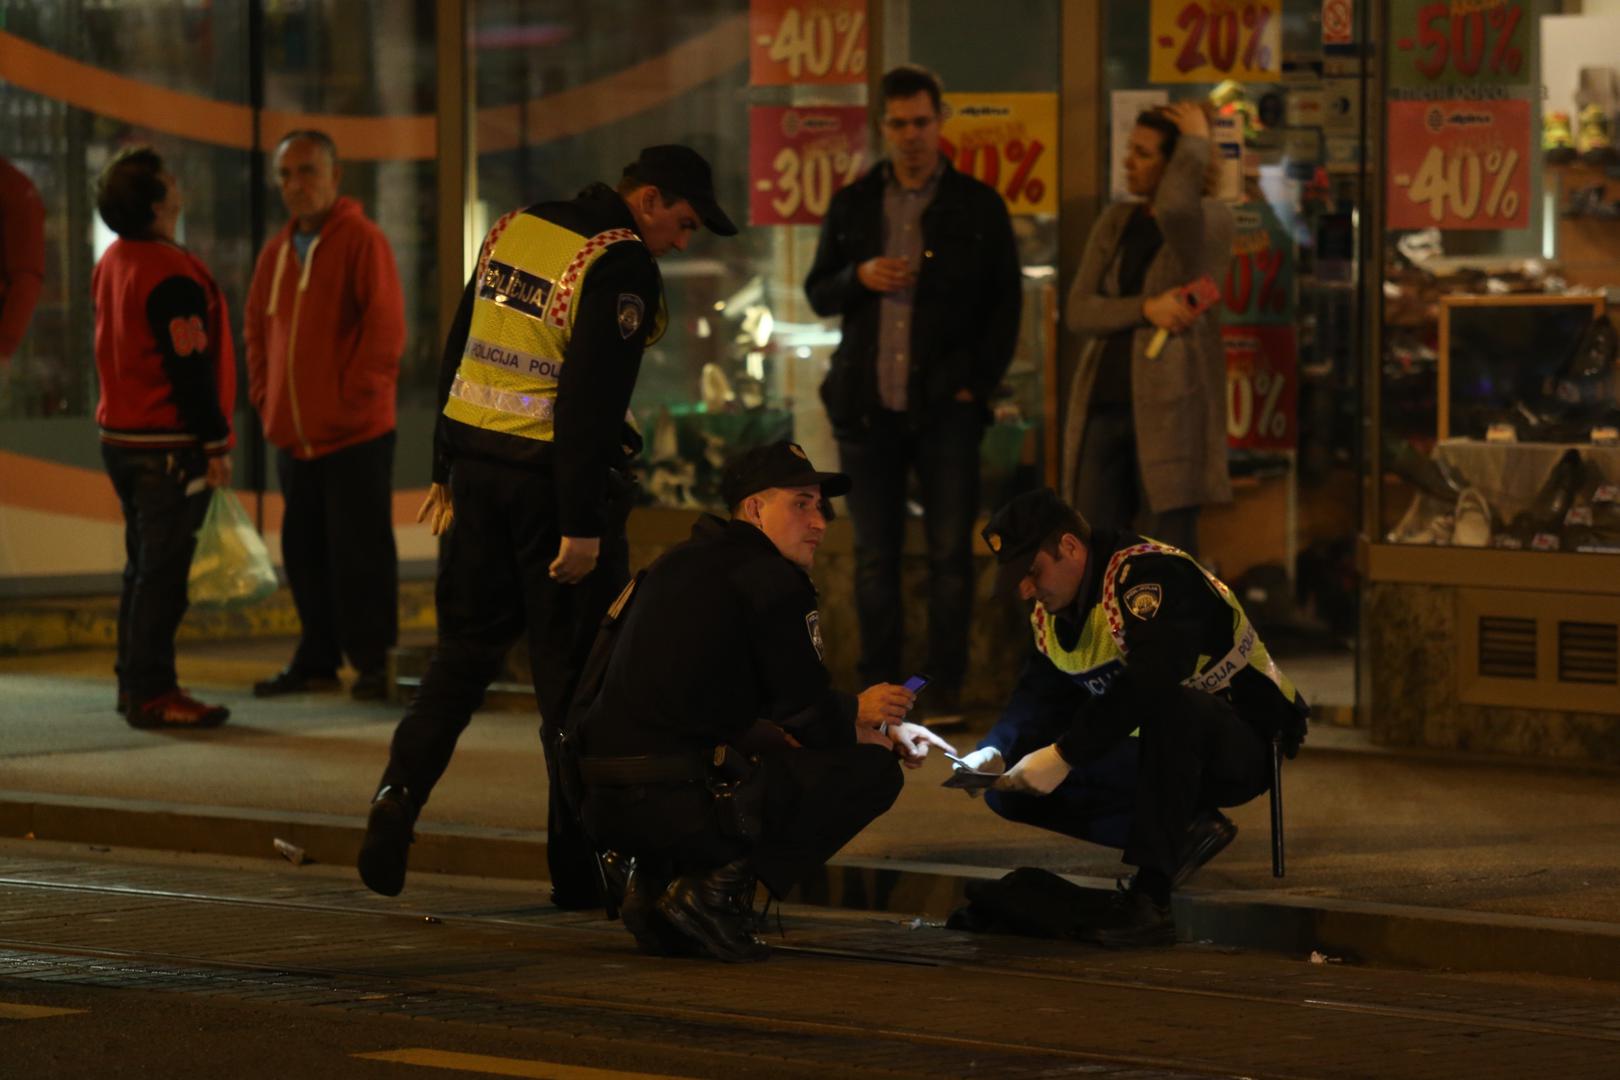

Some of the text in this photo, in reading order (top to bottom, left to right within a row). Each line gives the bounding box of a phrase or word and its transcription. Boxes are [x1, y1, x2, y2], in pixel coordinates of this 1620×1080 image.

[757, 9, 867, 78] -40%
[1158, 3, 1272, 75] -20%
[1396, 3, 1523, 80] -50%
[1394, 146, 1519, 221] -40%
